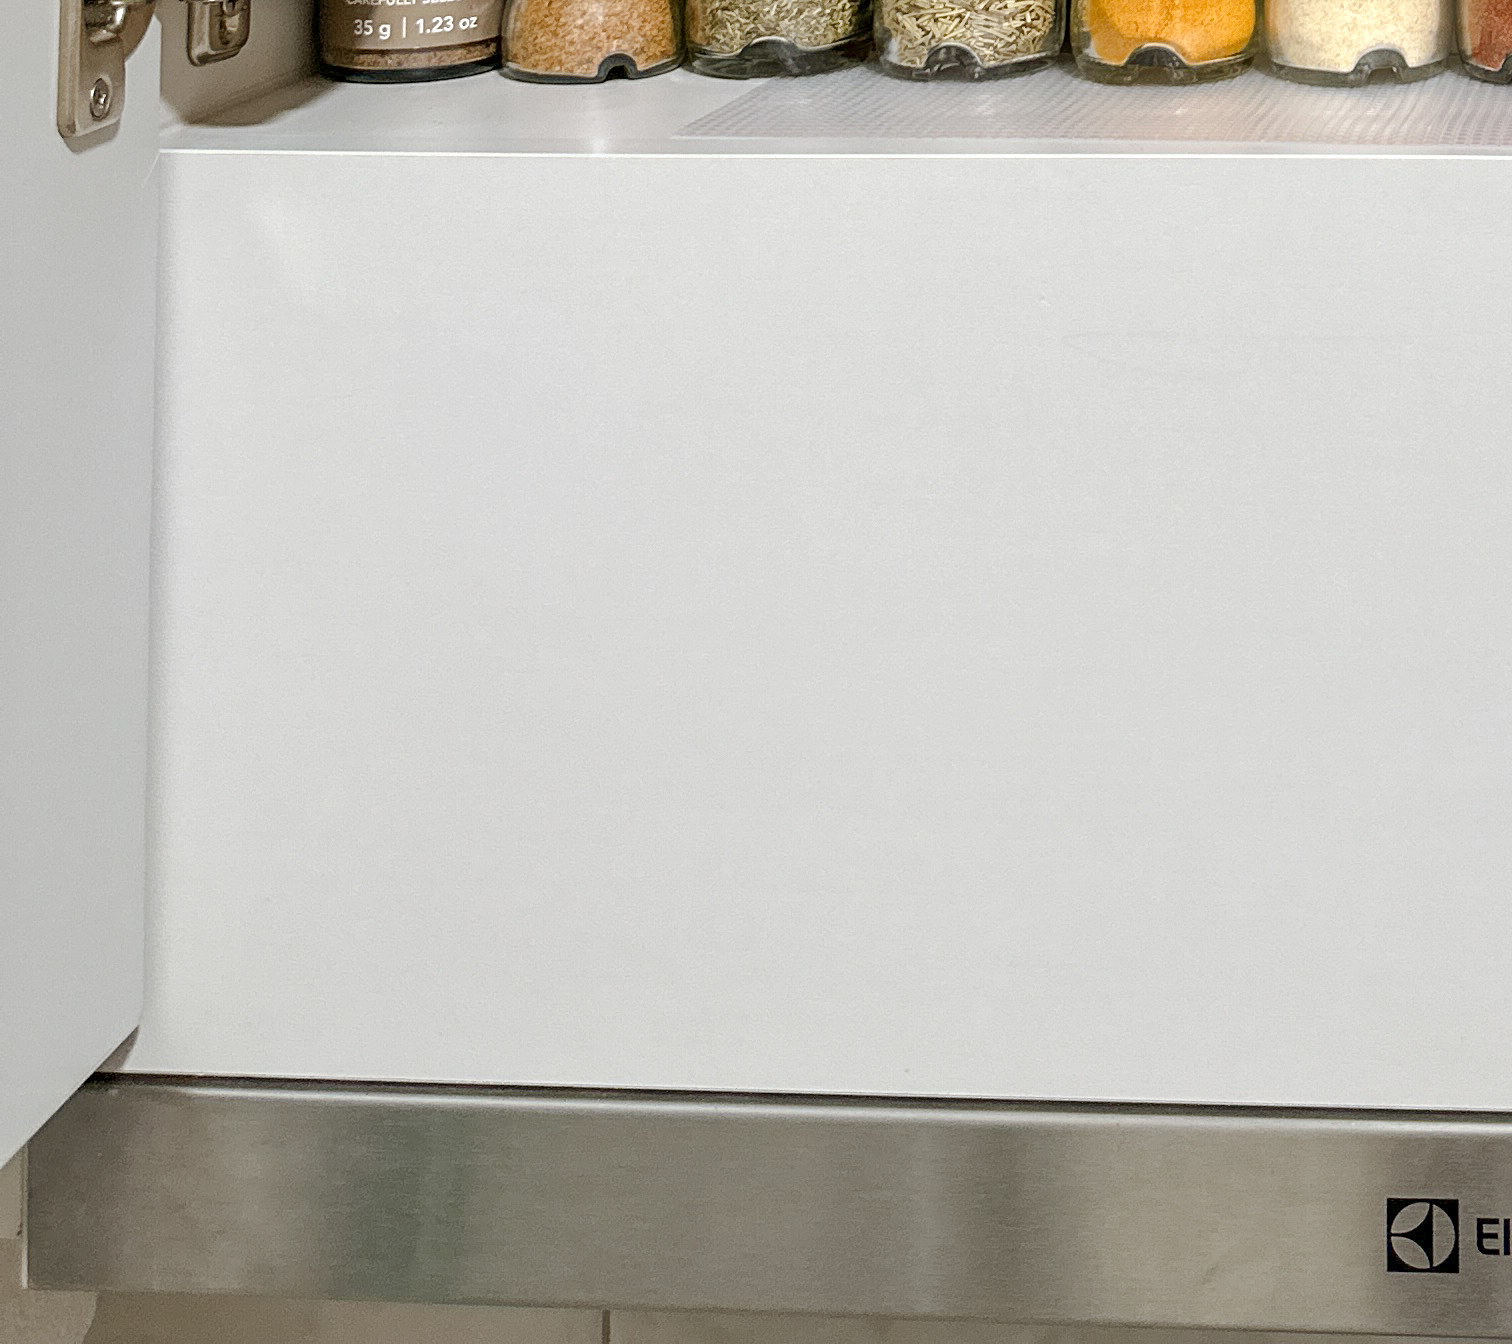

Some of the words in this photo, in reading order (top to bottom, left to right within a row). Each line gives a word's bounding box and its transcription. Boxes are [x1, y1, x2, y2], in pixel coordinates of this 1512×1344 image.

[354, 20, 373, 35] 35
[379, 24, 391, 40] g
[416, 16, 454, 34] 1.23
[459, 17, 477, 29] oz
